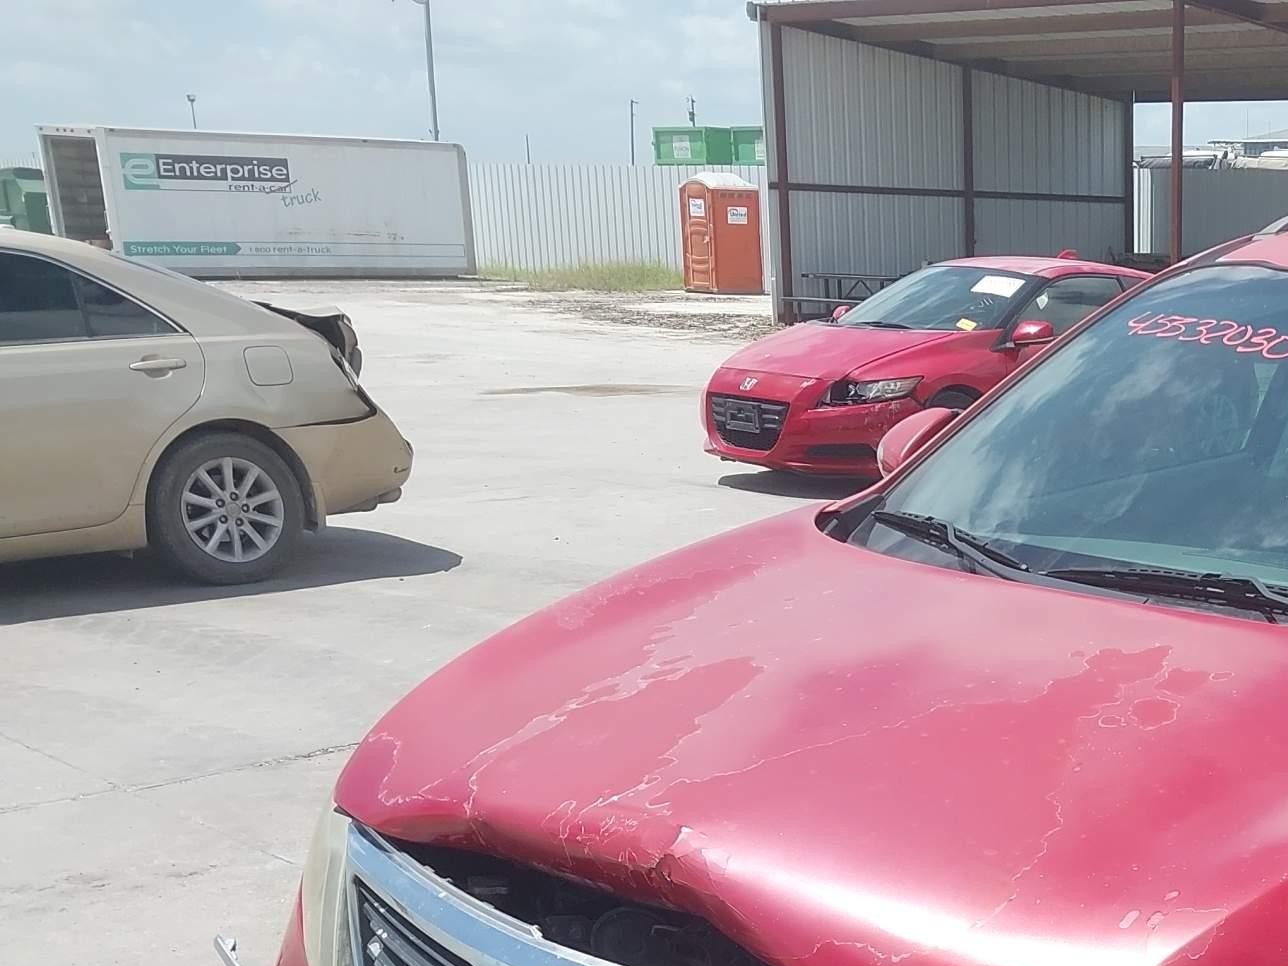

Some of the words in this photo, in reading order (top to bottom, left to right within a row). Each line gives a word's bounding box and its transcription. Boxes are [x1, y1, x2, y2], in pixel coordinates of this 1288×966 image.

[158, 159, 288, 182] Enterprise
[280, 188, 321, 208] truck
[130, 244, 170, 254] Stretch
[174, 245, 196, 254] Your
[200, 245, 228, 254] Fleet
